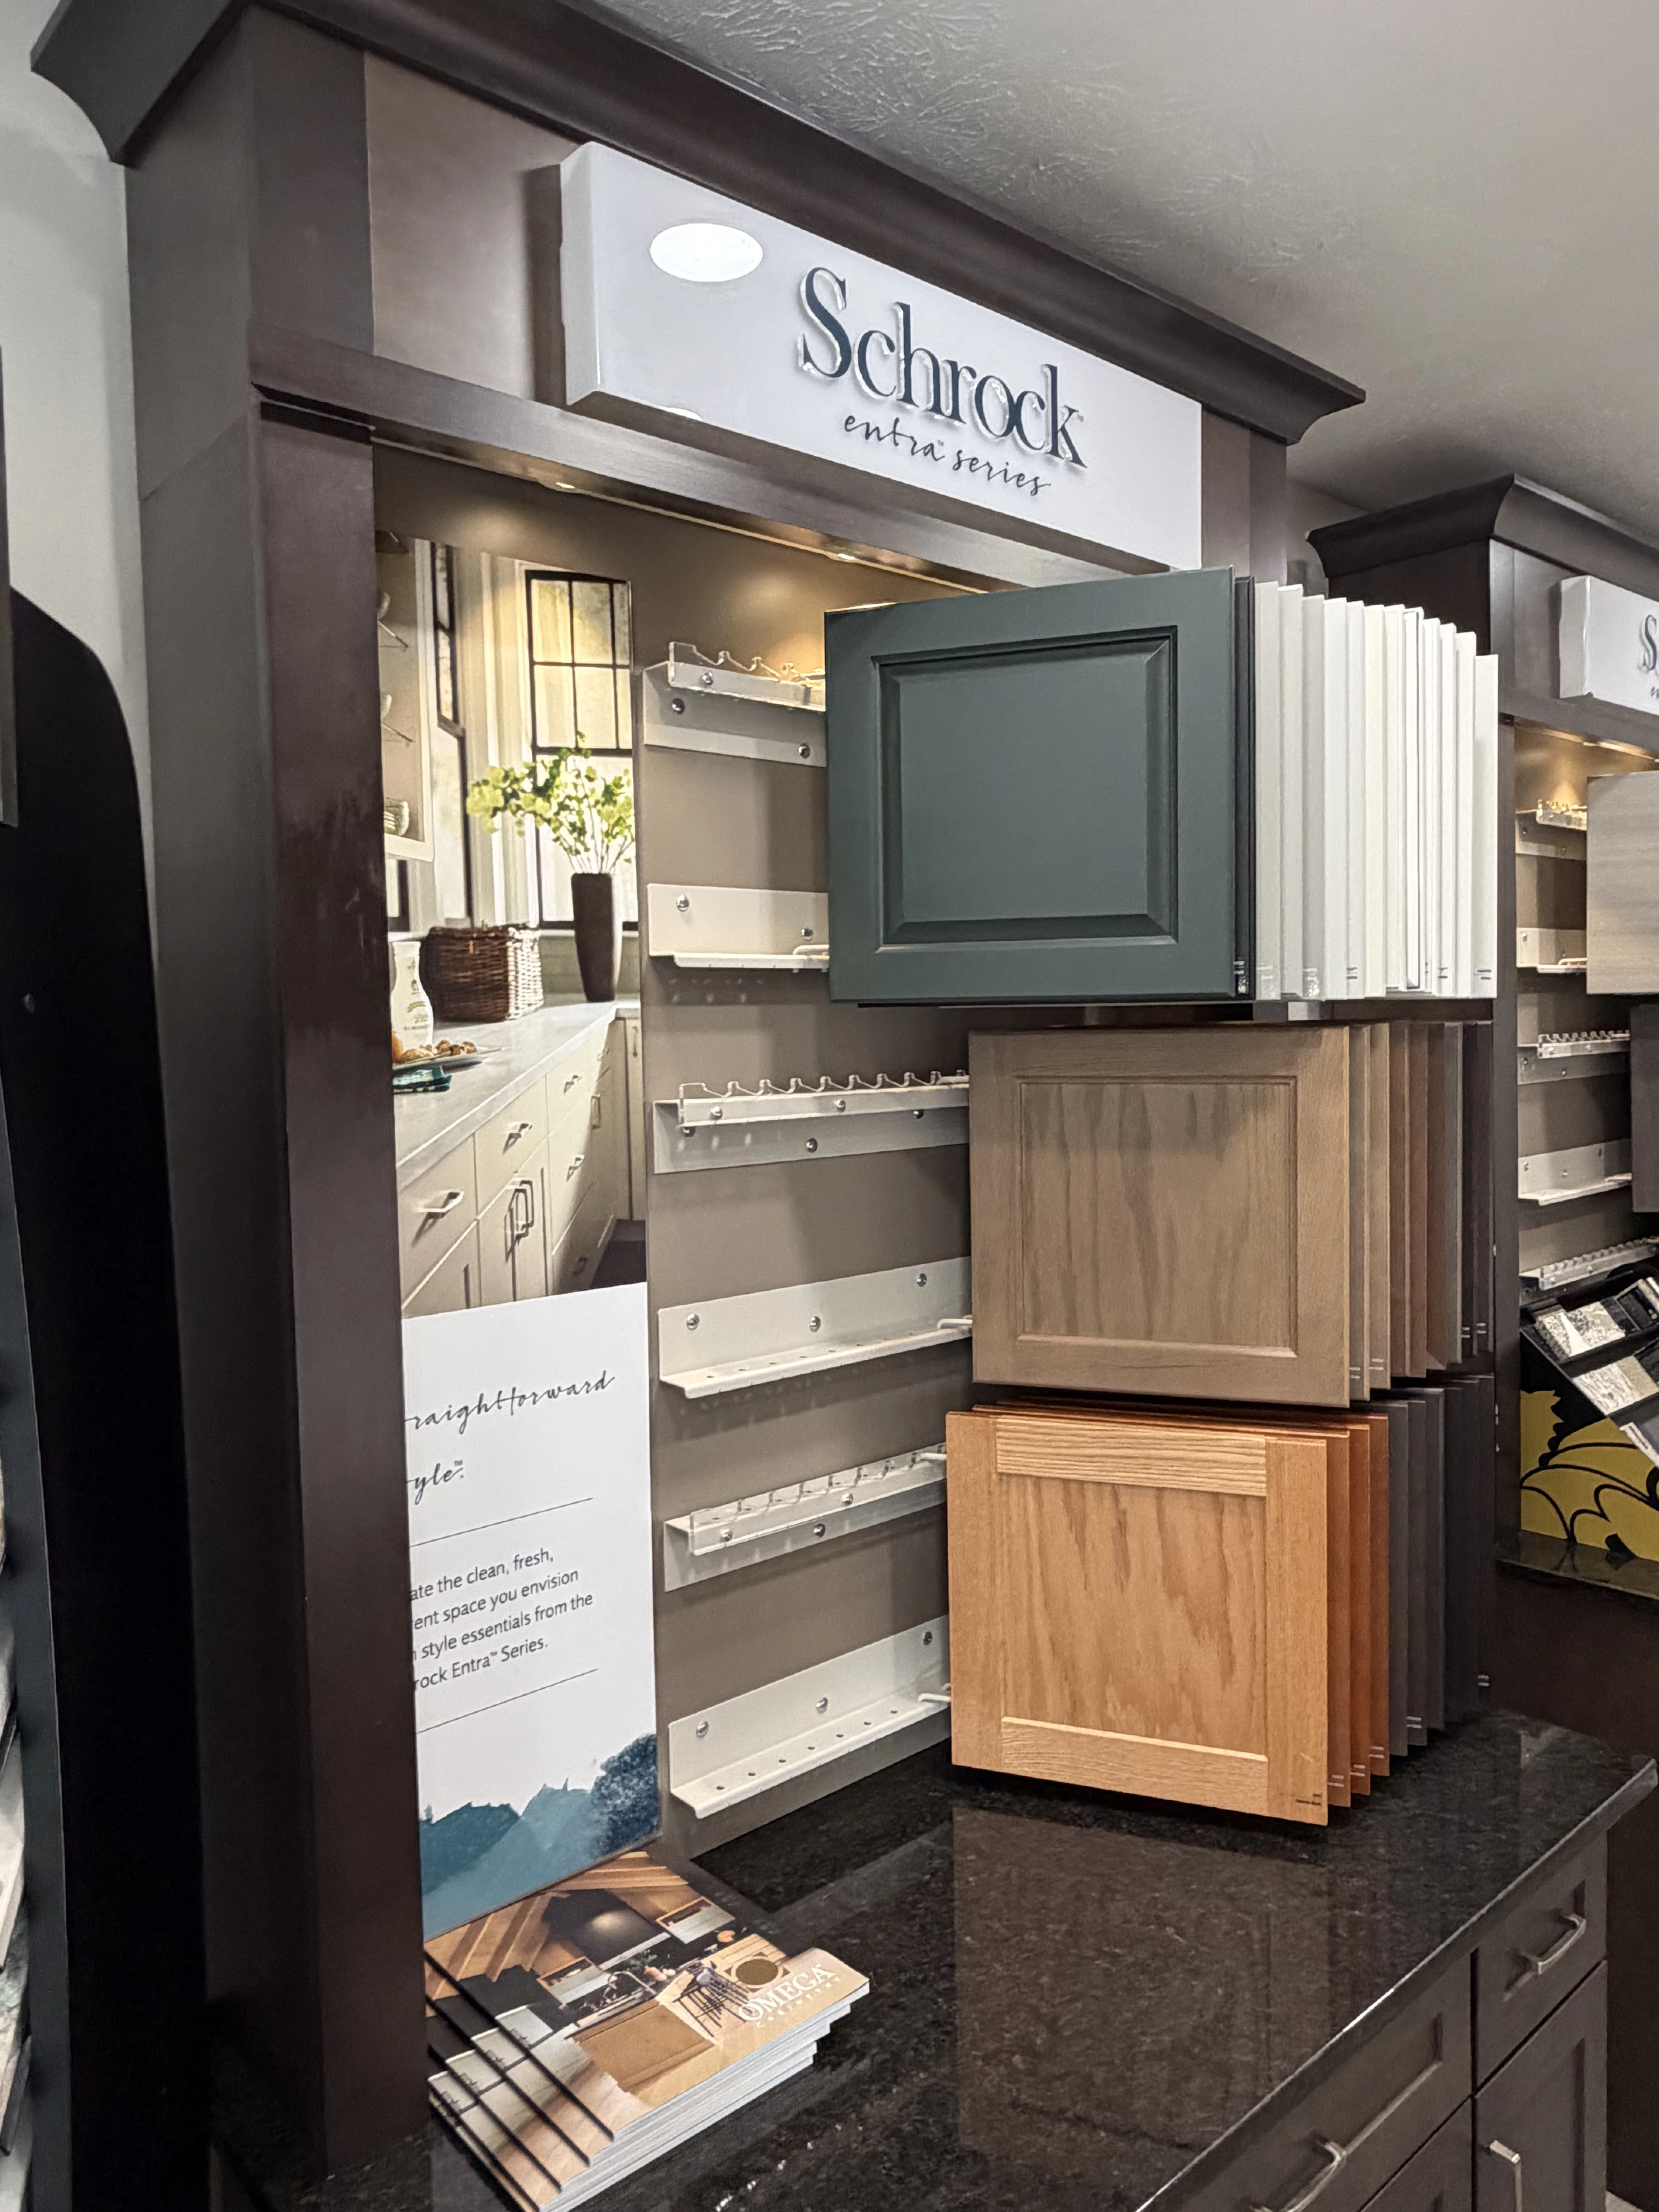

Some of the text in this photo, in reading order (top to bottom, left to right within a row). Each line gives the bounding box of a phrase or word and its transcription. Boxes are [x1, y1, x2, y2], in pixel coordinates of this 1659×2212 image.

[952, 450, 1051, 496] series
[437, 1575, 462, 1593] the
[467, 1564, 510, 1584] clean,
[514, 1547, 553, 1571] fresh,
[412, 1570, 579, 1630] ent space you envision
[421, 1635, 457, 1659] style
[462, 1611, 532, 1645] essentials
[535, 1605, 567, 1622] from
[571, 1594, 593, 1611] the
[501, 1638, 548, 1662] Series.
[738, 1966, 836, 2021] OMEGA
